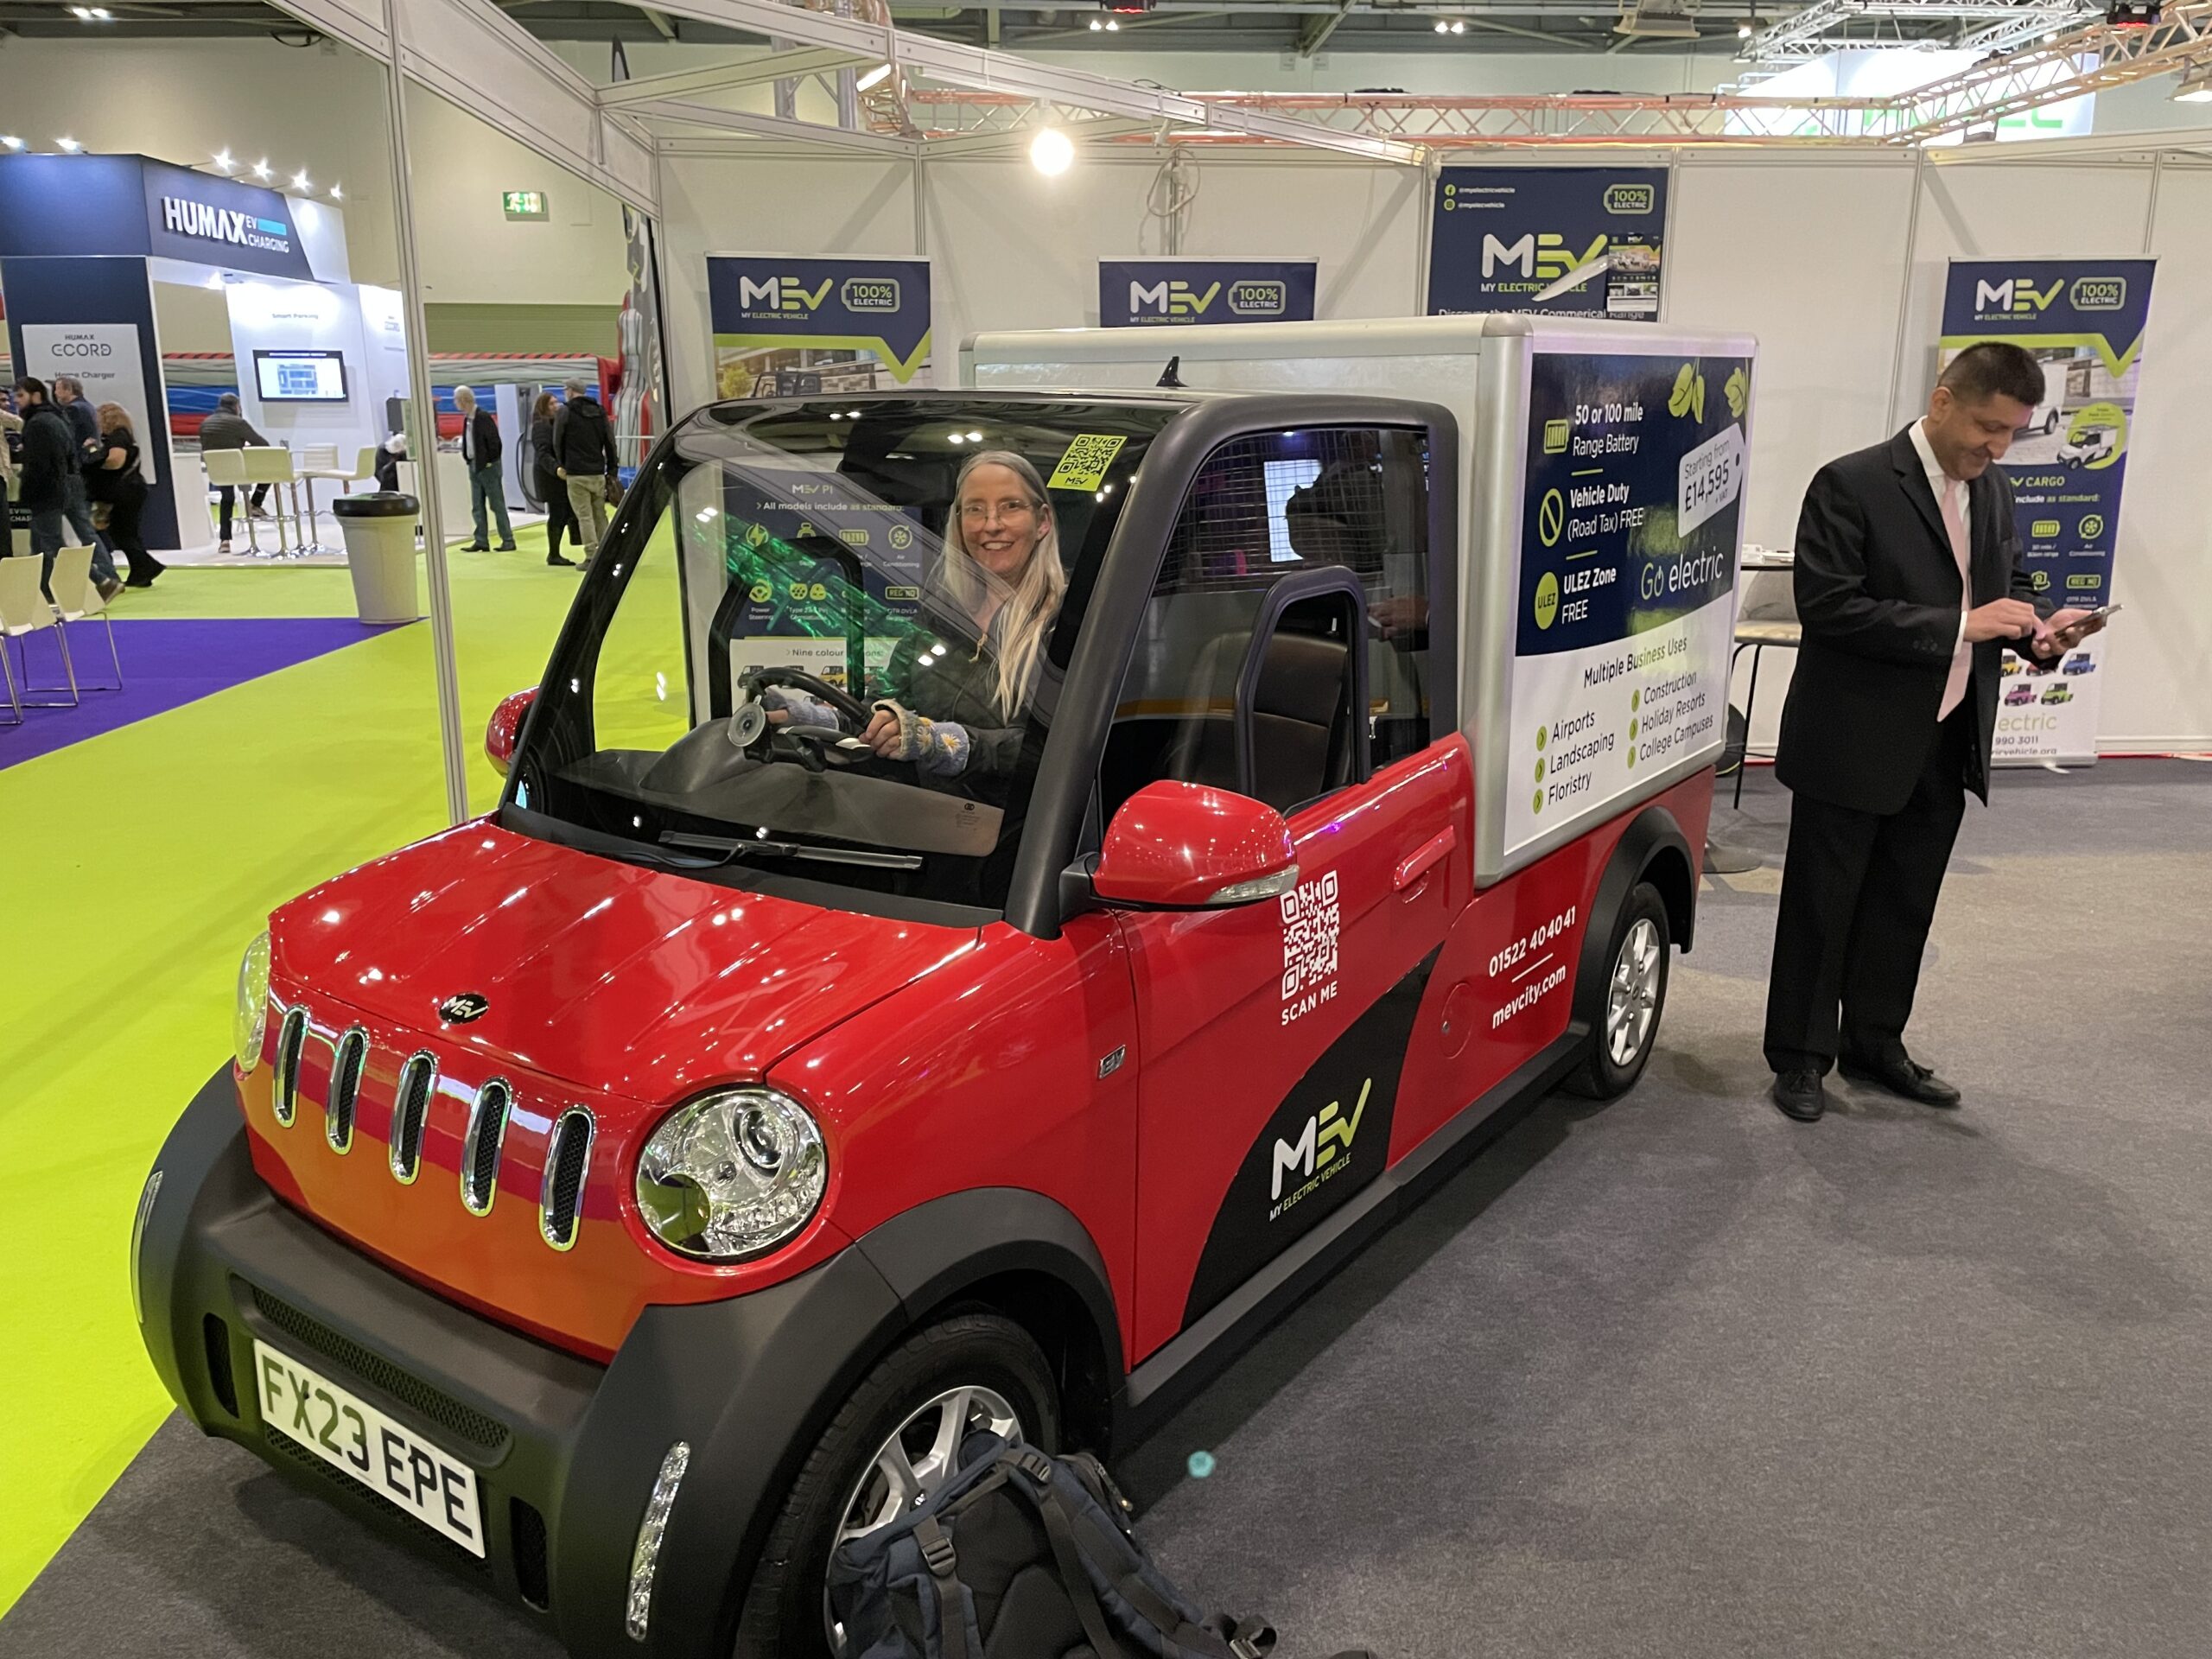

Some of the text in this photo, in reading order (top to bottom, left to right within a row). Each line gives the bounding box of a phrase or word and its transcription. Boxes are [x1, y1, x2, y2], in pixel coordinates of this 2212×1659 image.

[1614, 190, 1648, 201] 100%
[163, 195, 258, 245] HUMAX EV
[248, 233, 289, 254] CHARGING
[1481, 233, 1608, 278] MEV
[740, 276, 834, 311] MEV
[852, 285, 893, 298] 100%
[1129, 280, 1222, 314] MEV
[1238, 288, 1279, 301] 100%
[1480, 283, 1496, 293] MY
[1497, 283, 1545, 292] ELECTRIC
[1975, 278, 2065, 312] MEV
[2081, 283, 2119, 297] 100%
[81, 372, 115, 380] Charger
[1575, 401, 1643, 425] 50 or 100 mile
[1573, 433, 1640, 459] Range Battery
[1684, 439, 1729, 480] Starting from
[792, 484, 820, 494] MEV
[1065, 476, 1089, 485] MEV
[1569, 481, 1630, 509] Vehicle Duty
[1685, 458, 1729, 513] £14,595
[2025, 476, 2065, 487] CARGO
[763, 502, 776, 511] All
[778, 502, 812, 511] models
[814, 502, 848, 512] include
[862, 503, 905, 512] standard:
[2014, 494, 2045, 504] nclude
[2058, 493, 2101, 503] standard:
[1567, 506, 1644, 542] (Road Tax) FREE
[1563, 566, 1617, 594] ULEZ Zone
[1668, 545, 1724, 593] electric
[1537, 592, 1556, 609] ULEZ
[1561, 599, 1589, 626] FREE
[1583, 637, 1688, 689] Multiple Business Uses
[1643, 671, 1697, 705] Construction
[1552, 710, 1595, 744] Airports
[1641, 691, 1706, 734] Holiday Resorts
[1998, 713, 2057, 732] ectric
[1549, 732, 1615, 775] Landscaping
[1639, 715, 1713, 762] College Campuses
[1548, 771, 1592, 805] Floristry
[1489, 938, 1527, 977] 01522
[1281, 980, 1338, 1027] SCAN ME
[1492, 964, 1567, 1030] mevcity.com
[1271, 1077, 1372, 1202] MEV
[1268, 1152, 1351, 1223] MY ELECTRIC VEHICLE
[262, 1353, 474, 1541] FX23 EPE
